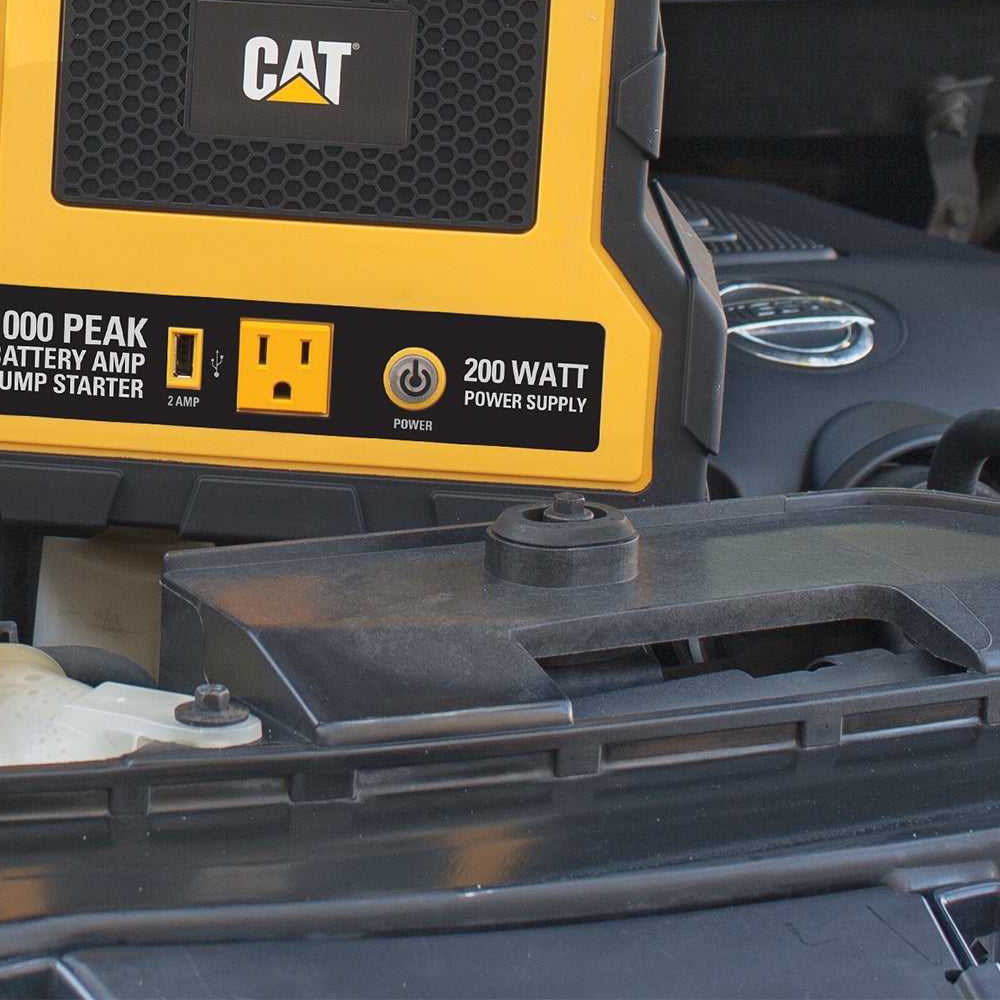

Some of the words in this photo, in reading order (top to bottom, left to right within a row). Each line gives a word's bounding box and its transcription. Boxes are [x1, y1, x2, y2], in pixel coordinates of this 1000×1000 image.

[242, 35, 352, 106] CAT
[63, 312, 148, 349] PEAK
[91, 351, 146, 375] AMP
[463, 357, 506, 384] 200
[511, 359, 589, 389] WATT
[53, 373, 144, 399] STARTER
[167, 395, 174, 407] 2
[175, 395, 200, 408] AMP
[464, 390, 523, 410] POWER
[526, 394, 588, 414] SUPPLY
[393, 417, 433, 431] POWER
